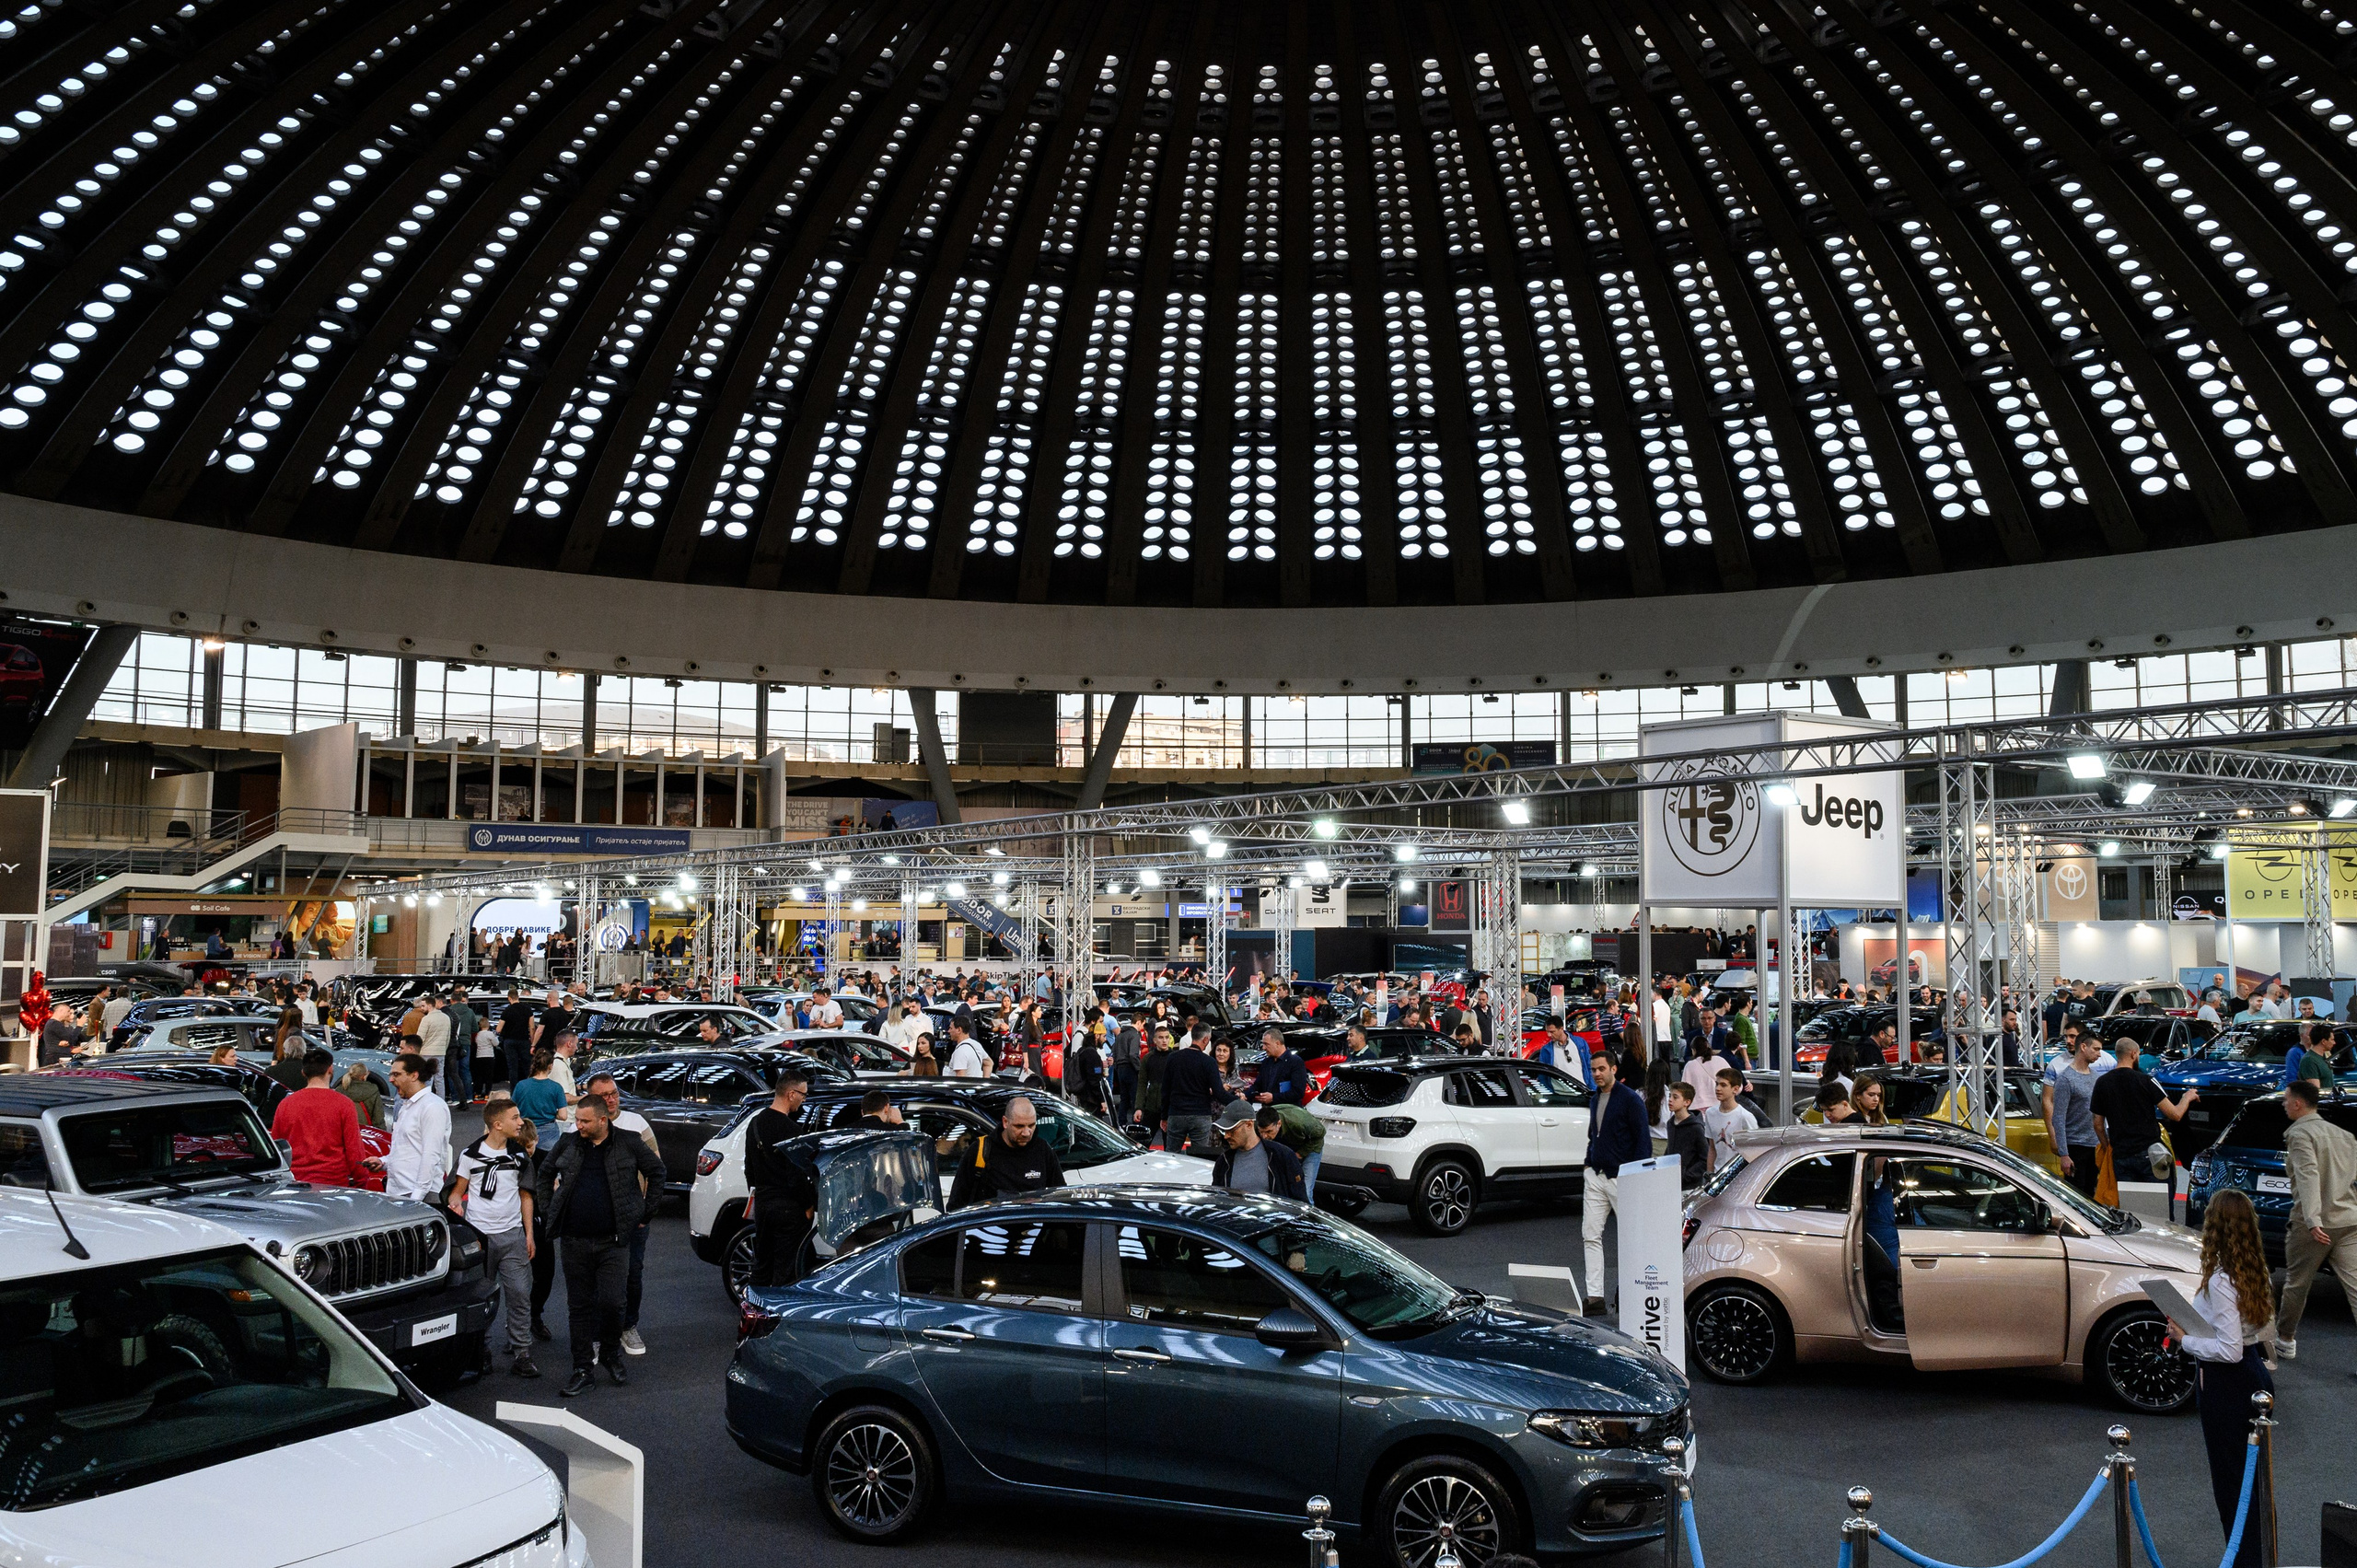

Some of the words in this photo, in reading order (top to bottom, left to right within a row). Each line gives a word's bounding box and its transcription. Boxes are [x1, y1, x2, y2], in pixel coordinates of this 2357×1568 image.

[804, 801, 828, 809] DRIVE
[1801, 784, 1883, 839] Jeep
[785, 816, 828, 830] MISS
[528, 835, 580, 843] ОСИГУРАЊЕ
[595, 836, 629, 844] Пријатељ
[958, 902, 993, 929] OSIGURANJE
[1664, 1316, 1669, 1324] by
[420, 1323, 450, 1337] Wrangler
